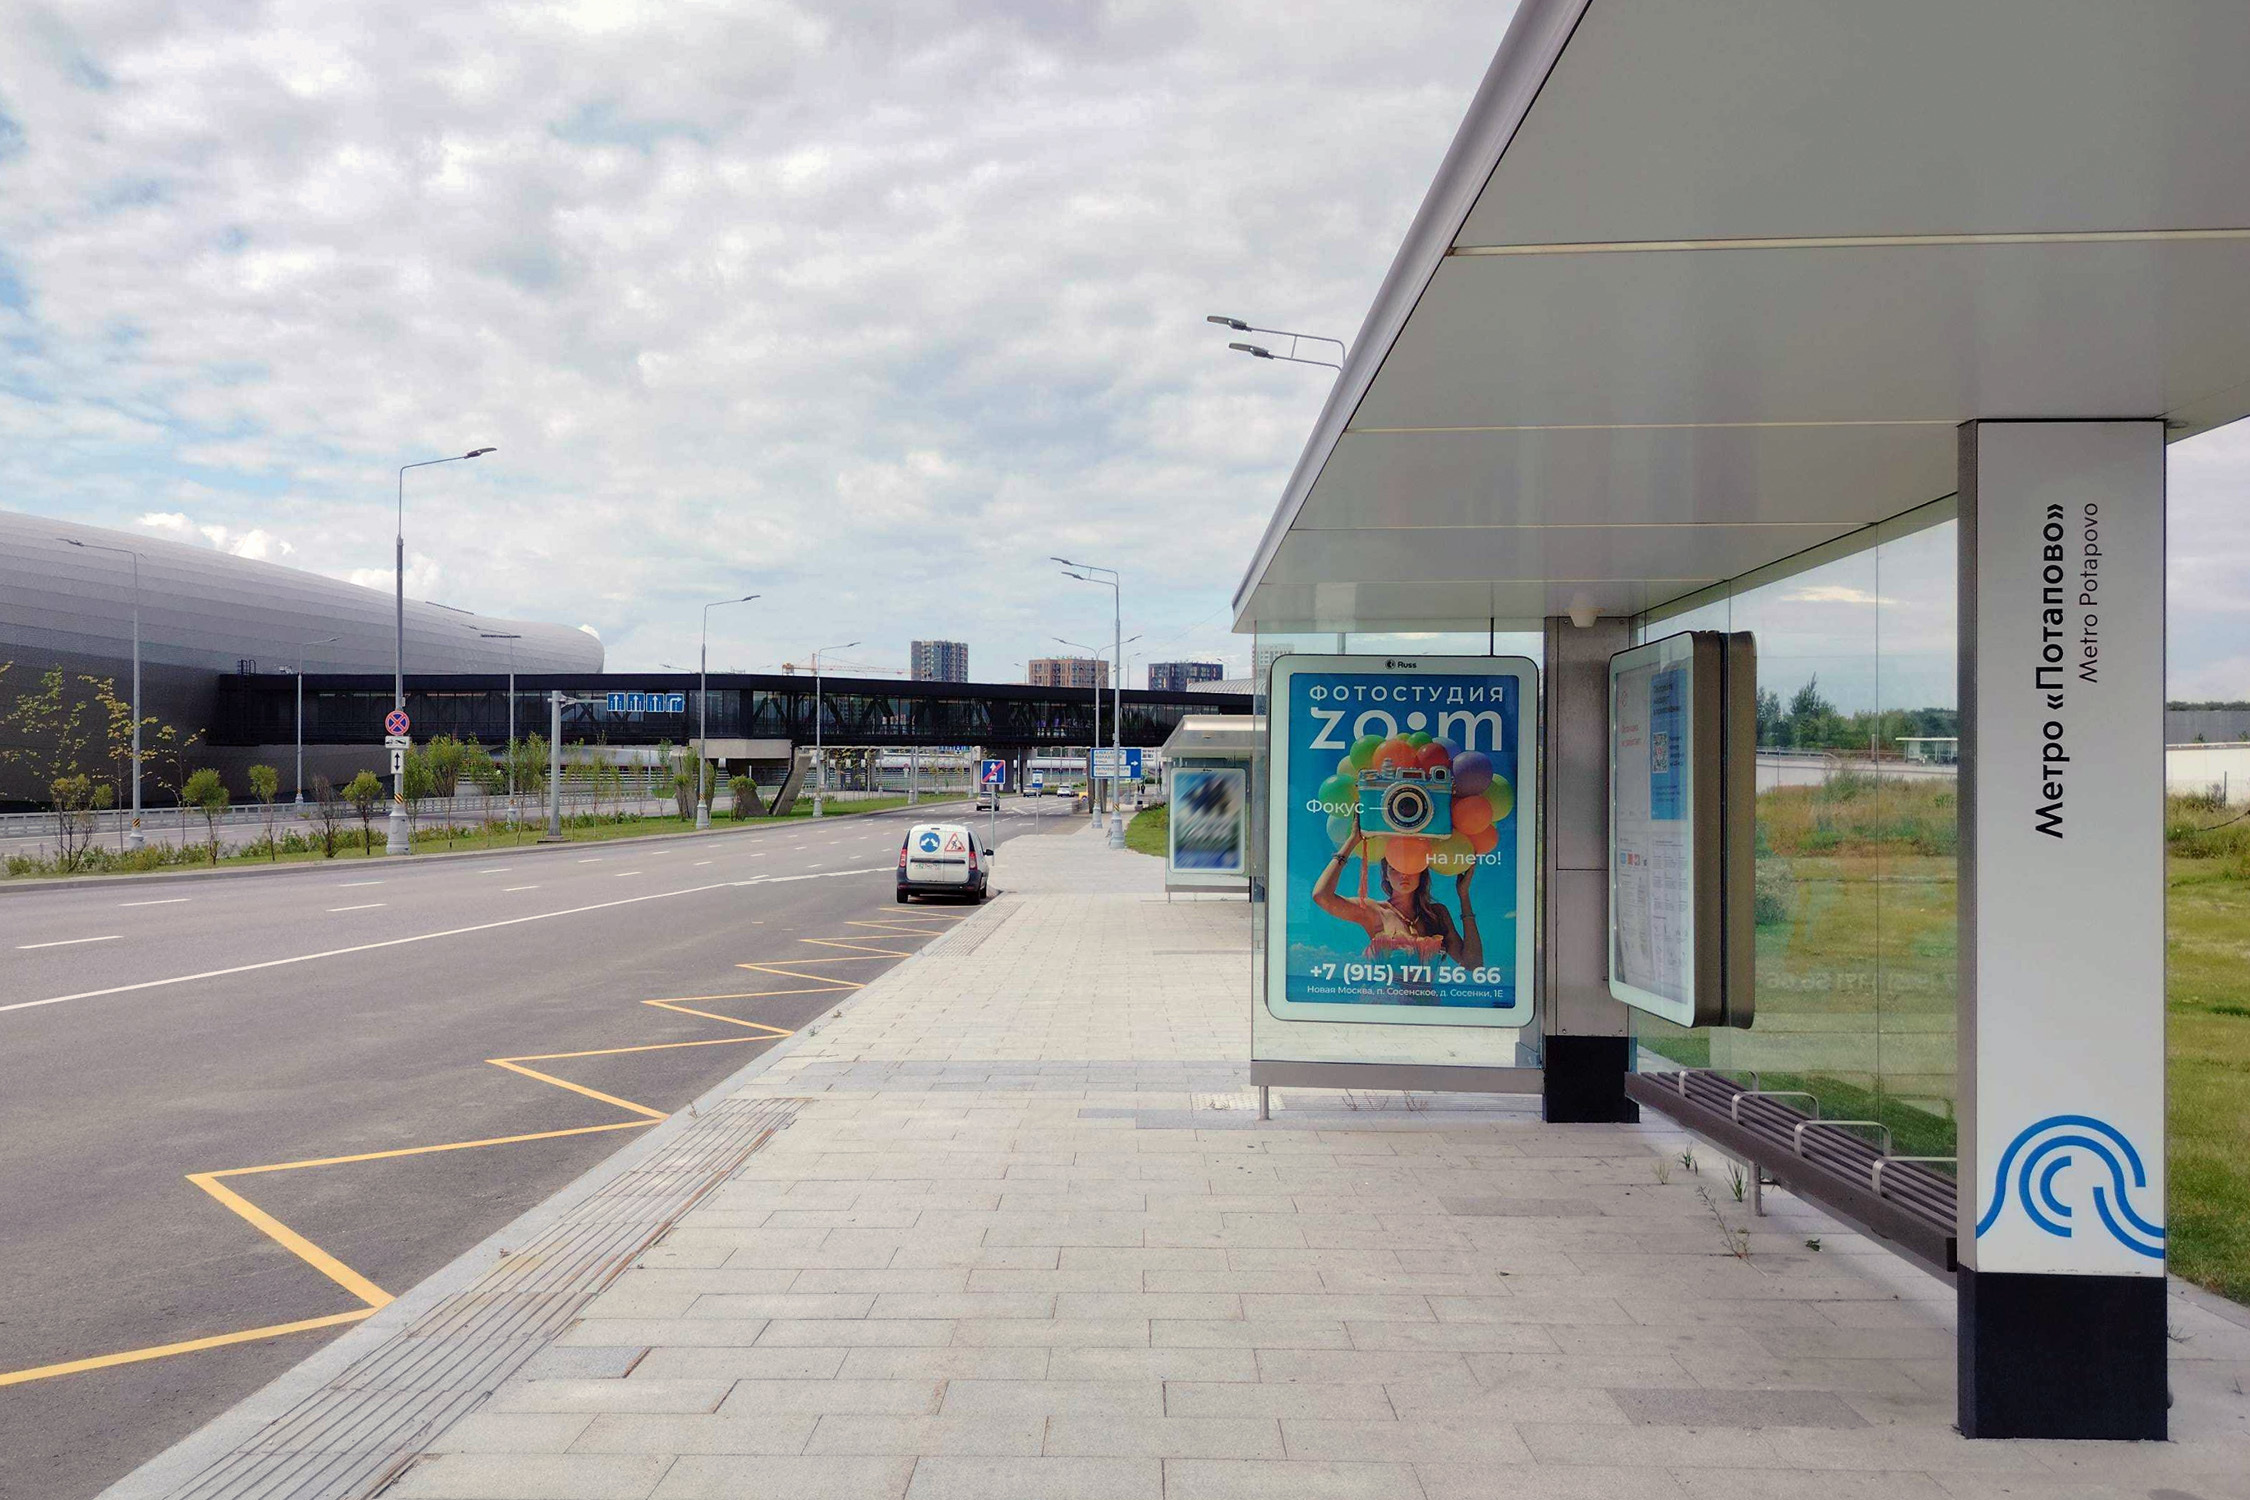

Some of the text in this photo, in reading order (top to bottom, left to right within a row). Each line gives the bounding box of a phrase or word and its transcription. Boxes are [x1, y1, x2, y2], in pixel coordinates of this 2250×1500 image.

[2079, 502, 2102, 683] Metro Potapovo
[1397, 661, 1417, 669] Russ
[2035, 503, 2070, 839] Метро «Потапово»
[1309, 685, 1503, 704] ФОТОСТУДИЯ
[1306, 799, 1365, 817] Фокус
[1425, 851, 1501, 865] на лето!
[1310, 963, 1501, 986] +7 (915) 171 56 66
[1307, 986, 1336, 994] Новая
[1338, 986, 1375, 996] Москва,
[1387, 987, 1438, 997] Сосенское,
[1450, 989, 1492, 998] Сосенки,
